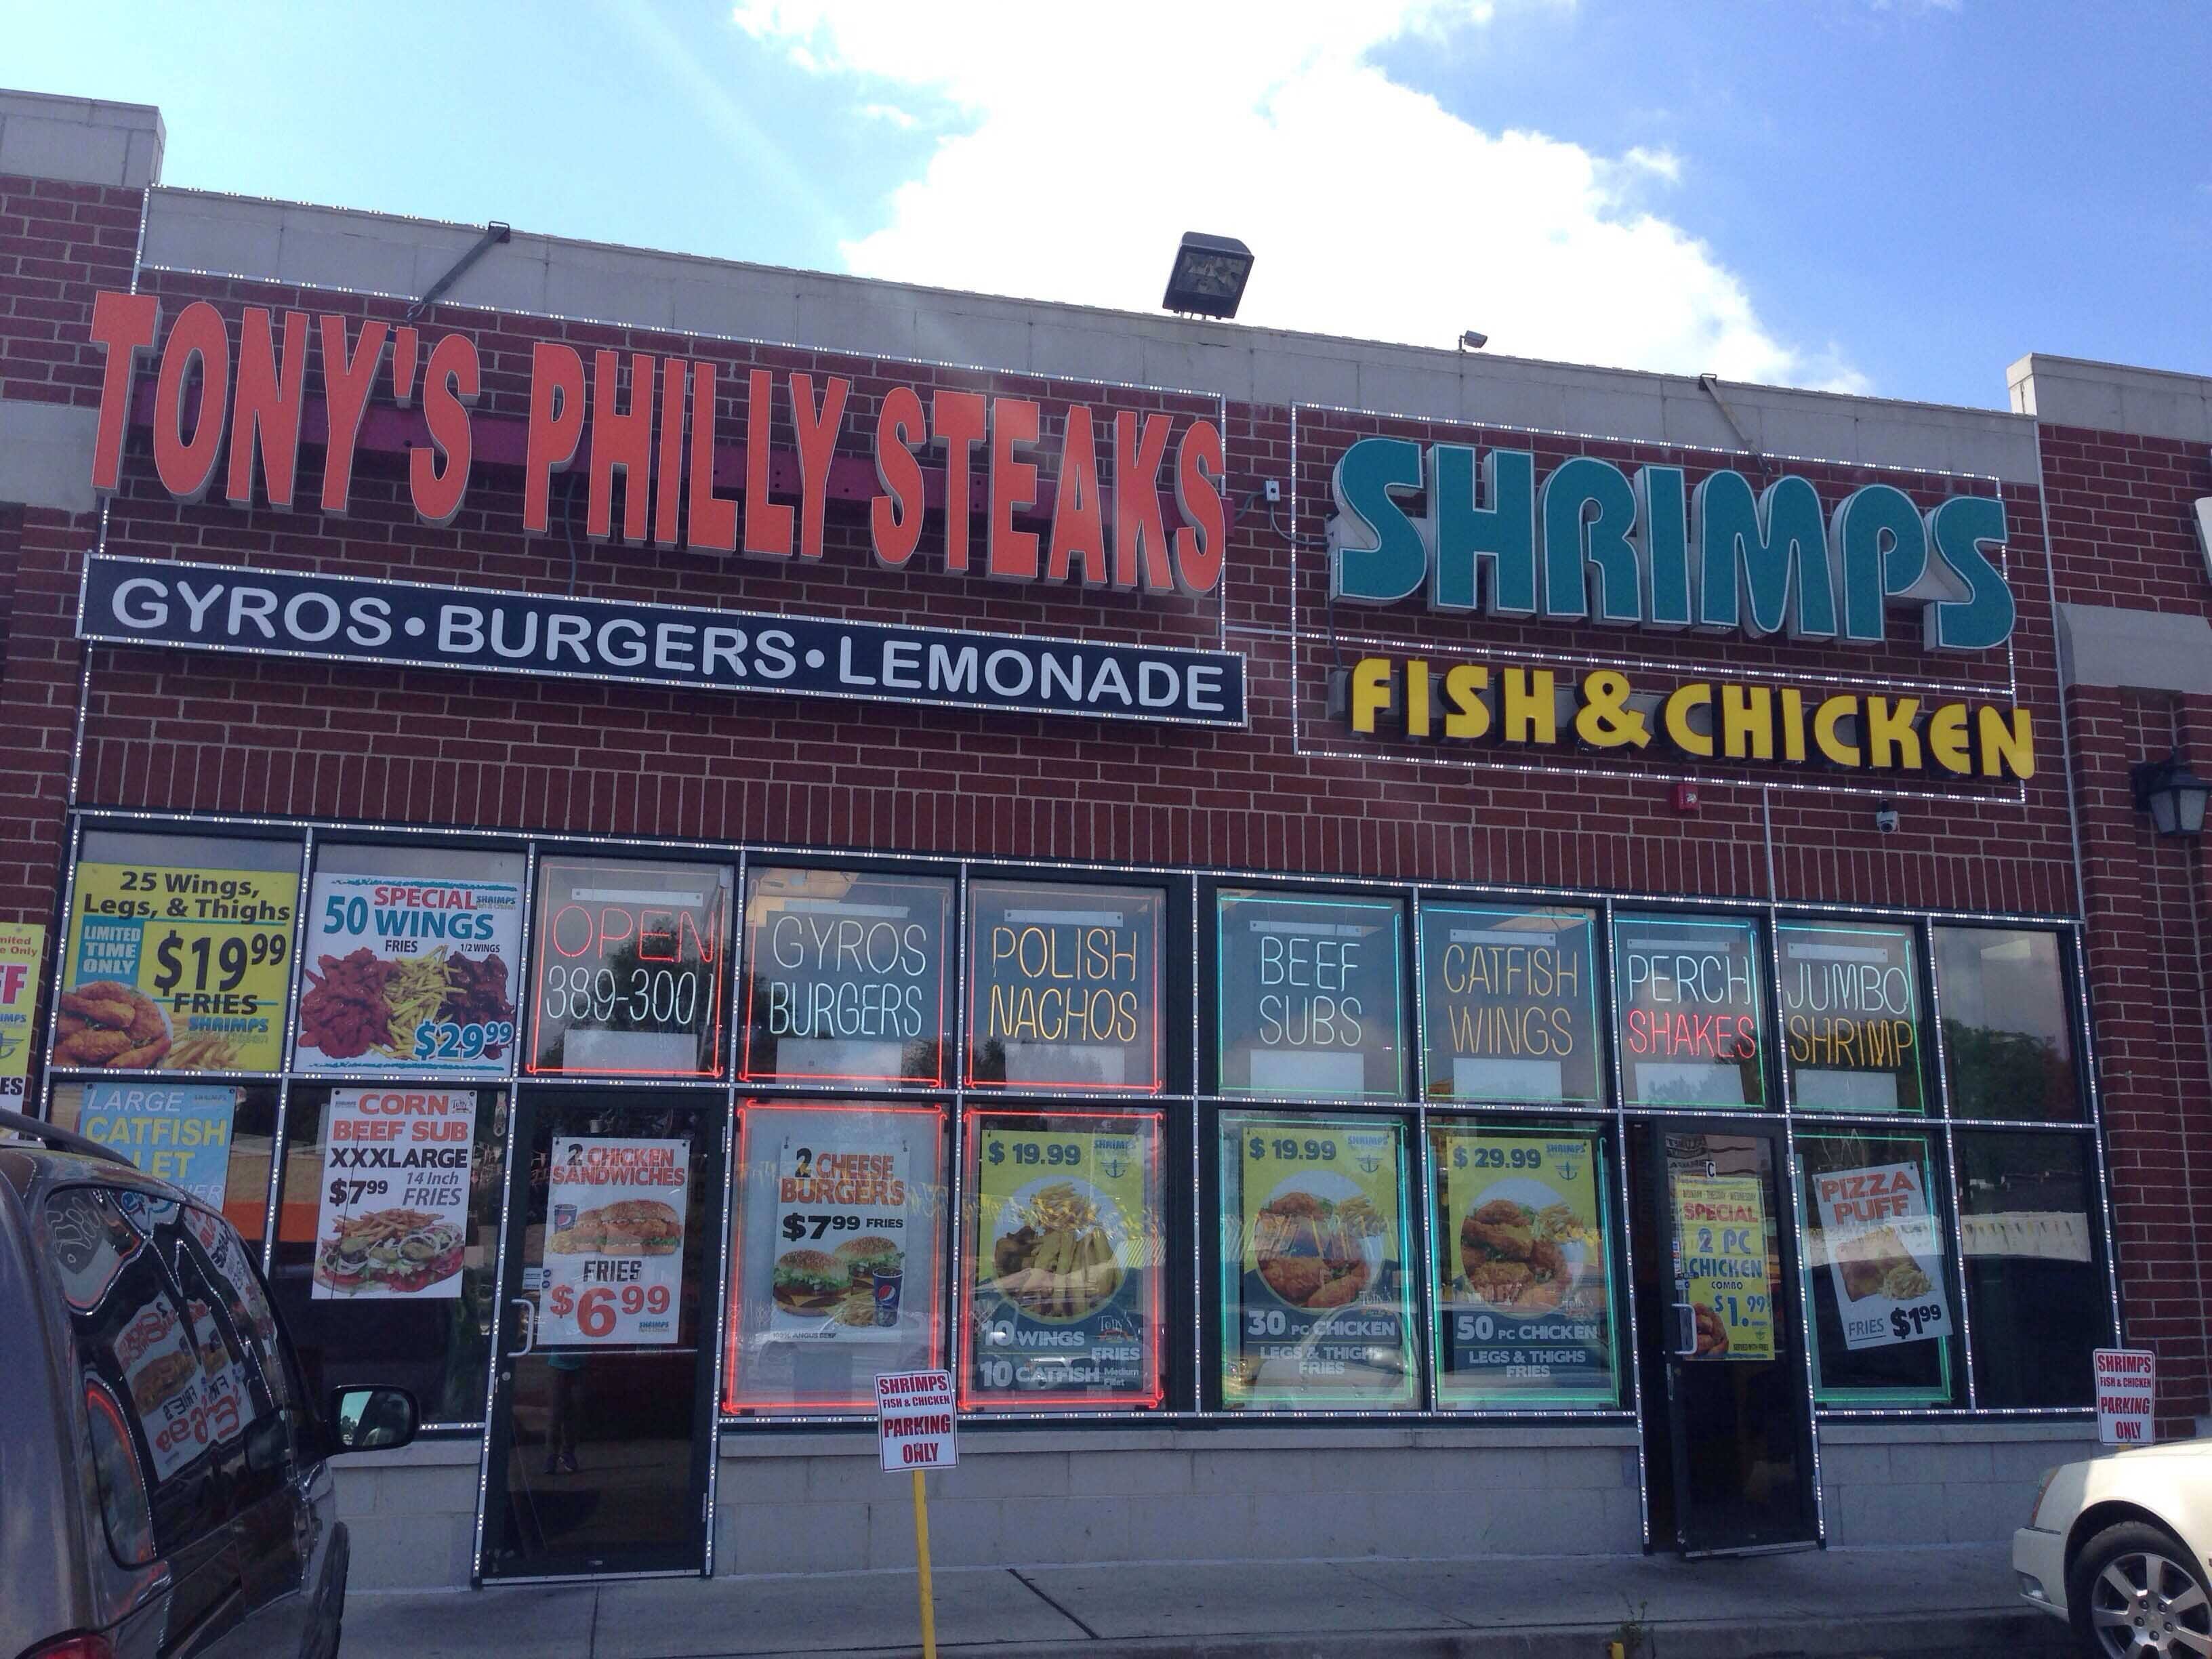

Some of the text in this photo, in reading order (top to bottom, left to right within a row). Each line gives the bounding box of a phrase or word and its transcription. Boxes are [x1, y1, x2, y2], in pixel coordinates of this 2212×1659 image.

[89, 290, 1227, 594] TONY'S PHILLY STEAKS
[1330, 437, 2017, 652] SHRIMPS
[111, 577, 1225, 712] GYROS BURGERS LEMONADE
[1349, 657, 2034, 781] FISH & CHICKEN
[120, 871, 260, 900] 25 Wings,
[83, 893, 291, 925] Legs, & Thighs
[373, 886, 478, 910] SPECIAL
[323, 895, 494, 940] 50 WINGS
[84, 925, 141, 942] LIMITED
[552, 905, 715, 963] OPEN
[85, 942, 136, 958] TIME
[385, 939, 418, 953] FRIES
[460, 943, 500, 953] 1/2 WINGS
[772, 916, 927, 977] GYROS
[992, 926, 1138, 981] POLISH
[83, 959, 136, 975] ONLY
[1259, 935, 1361, 991] BEEF
[1443, 943, 1578, 999] CATFISH
[1628, 954, 1752, 1005] PERCH
[1786, 964, 1909, 1014] JUMBO
[173, 993, 258, 1015] FRIES
[546, 965, 714, 1026] 389-3001
[769, 981, 923, 1038] BURGERS
[989, 987, 1138, 1042] NACHOS
[1258, 996, 1362, 1048] SUBS
[1448, 1006, 1574, 1057] WINGS
[1629, 1010, 1755, 1059] SHAKES
[1788, 1015, 1914, 1068] SHRIMP
[87, 1089, 185, 1112] LARGE
[359, 1094, 449, 1115] CORN
[85, 1116, 227, 1146] CATFISH
[332, 1120, 468, 1142] BEEF SUB
[329, 1147, 468, 1168] XXXLARGE
[567, 1143, 674, 1167] 2 CHICKEN
[1012, 1143, 1082, 1166] 19.99
[1271, 1139, 1337, 1161] 19.99
[1474, 1148, 1541, 1169] 29.99
[795, 1148, 894, 1179] 2 CHEESE
[407, 1172, 459, 1185] 14 Inch
[552, 1166, 685, 1185] SANDWICHES
[1821, 1171, 1916, 1202] PIZZA
[402, 1188, 462, 1206] FRIES
[781, 1178, 906, 1205] BURGERS
[1683, 1202, 1758, 1223] SPECIAL
[1833, 1194, 1908, 1225] PUFF
[866, 1218, 903, 1229] FRIES
[1698, 1228, 1751, 1254] 2 PC
[583, 1260, 642, 1282] FRIES
[1689, 1258, 1762, 1278] CHICKEN
[1711, 1282, 1743, 1290] COMBO
[982, 1320, 1085, 1347] 10 WINGS
[1248, 1310, 1395, 1336] 30 PC CHICKEN
[1457, 1315, 1598, 1340] 50 PC CHICKEN
[1848, 1318, 1884, 1336] FRIES
[1092, 1347, 1141, 1361] FRIES
[1260, 1346, 1303, 1360] LEGS
[1469, 1349, 1586, 1364] LEGS & THIGHS
[2097, 1355, 2151, 1373] SHRIMPS
[980, 1361, 1099, 1387] 10 CATFISH
[1298, 1361, 1345, 1375] FRIES
[1506, 1365, 1551, 1378] FRIES
[879, 1375, 947, 1395] SHRIMPS
[2100, 1377, 2151, 1388] FISH & CHICKEN
[883, 1395, 950, 1408] FISH & CHICKEN
[2101, 1397, 2150, 1414] PARKING
[884, 1414, 950, 1437] PARKING
[2116, 1420, 2141, 1439] ONLY
[903, 1442, 939, 1464] ONLY
